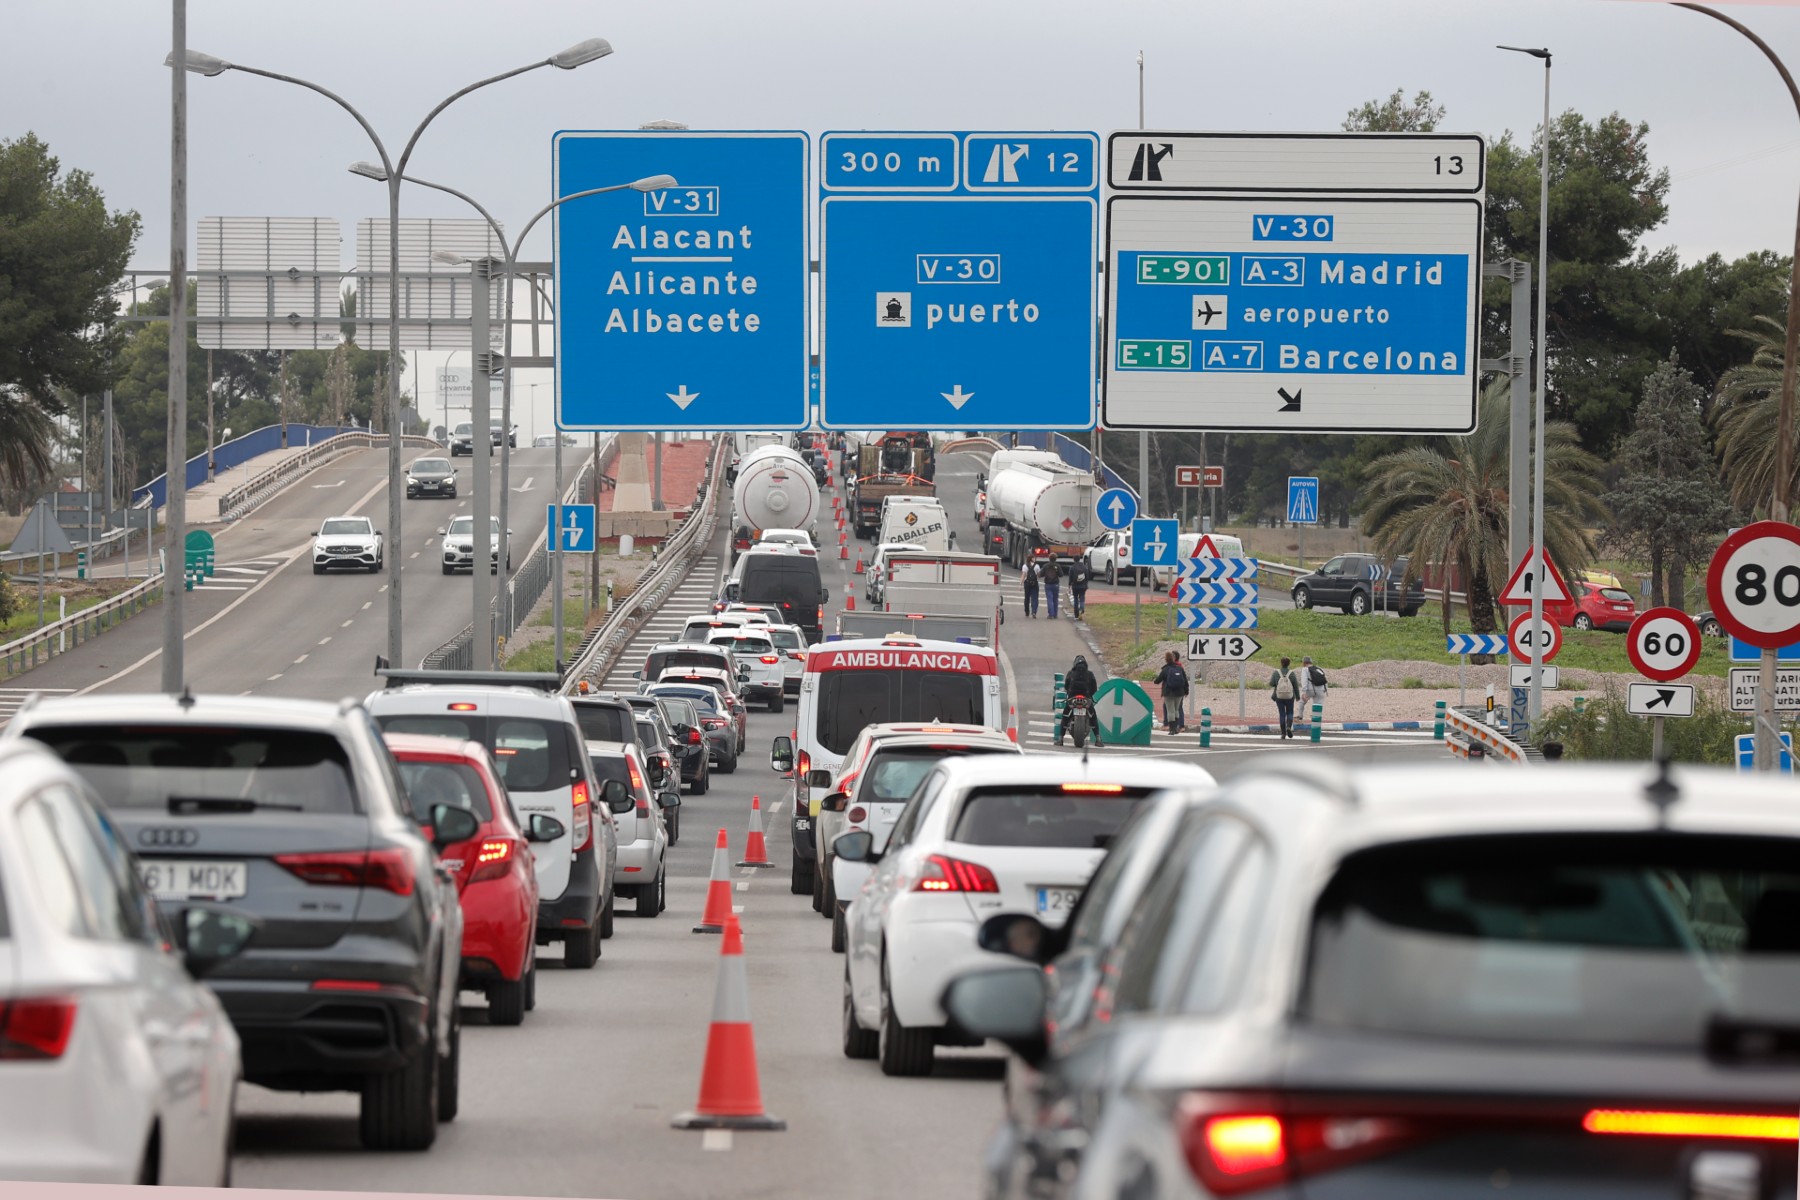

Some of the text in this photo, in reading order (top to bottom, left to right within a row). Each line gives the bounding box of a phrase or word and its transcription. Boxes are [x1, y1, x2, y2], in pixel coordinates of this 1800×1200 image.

[841, 152, 940, 173] 300 m
[1047, 152, 1079, 173] 12
[1434, 155, 1463, 175] 13
[650, 191, 714, 211] V-31
[612, 225, 752, 249] Alacant
[1256, 217, 1330, 238] V-30
[922, 259, 995, 279] V-30
[1141, 260, 1443, 285] E-901 A-3 Madrid
[606, 271, 757, 295] Alicante
[604, 308, 760, 333] Albacete
[927, 299, 1039, 330] puerto
[1243, 305, 1390, 328] aeropuerto
[1122, 345, 1458, 371] E-15 A-7 Barcelona
[890, 523, 942, 543] CABALLER
[1735, 563, 1800, 607] 80
[1218, 637, 1243, 656] 13
[1644, 632, 1685, 656] 60
[832, 653, 971, 670] AMBULANCIA
[1736, 698, 1754, 707] por
